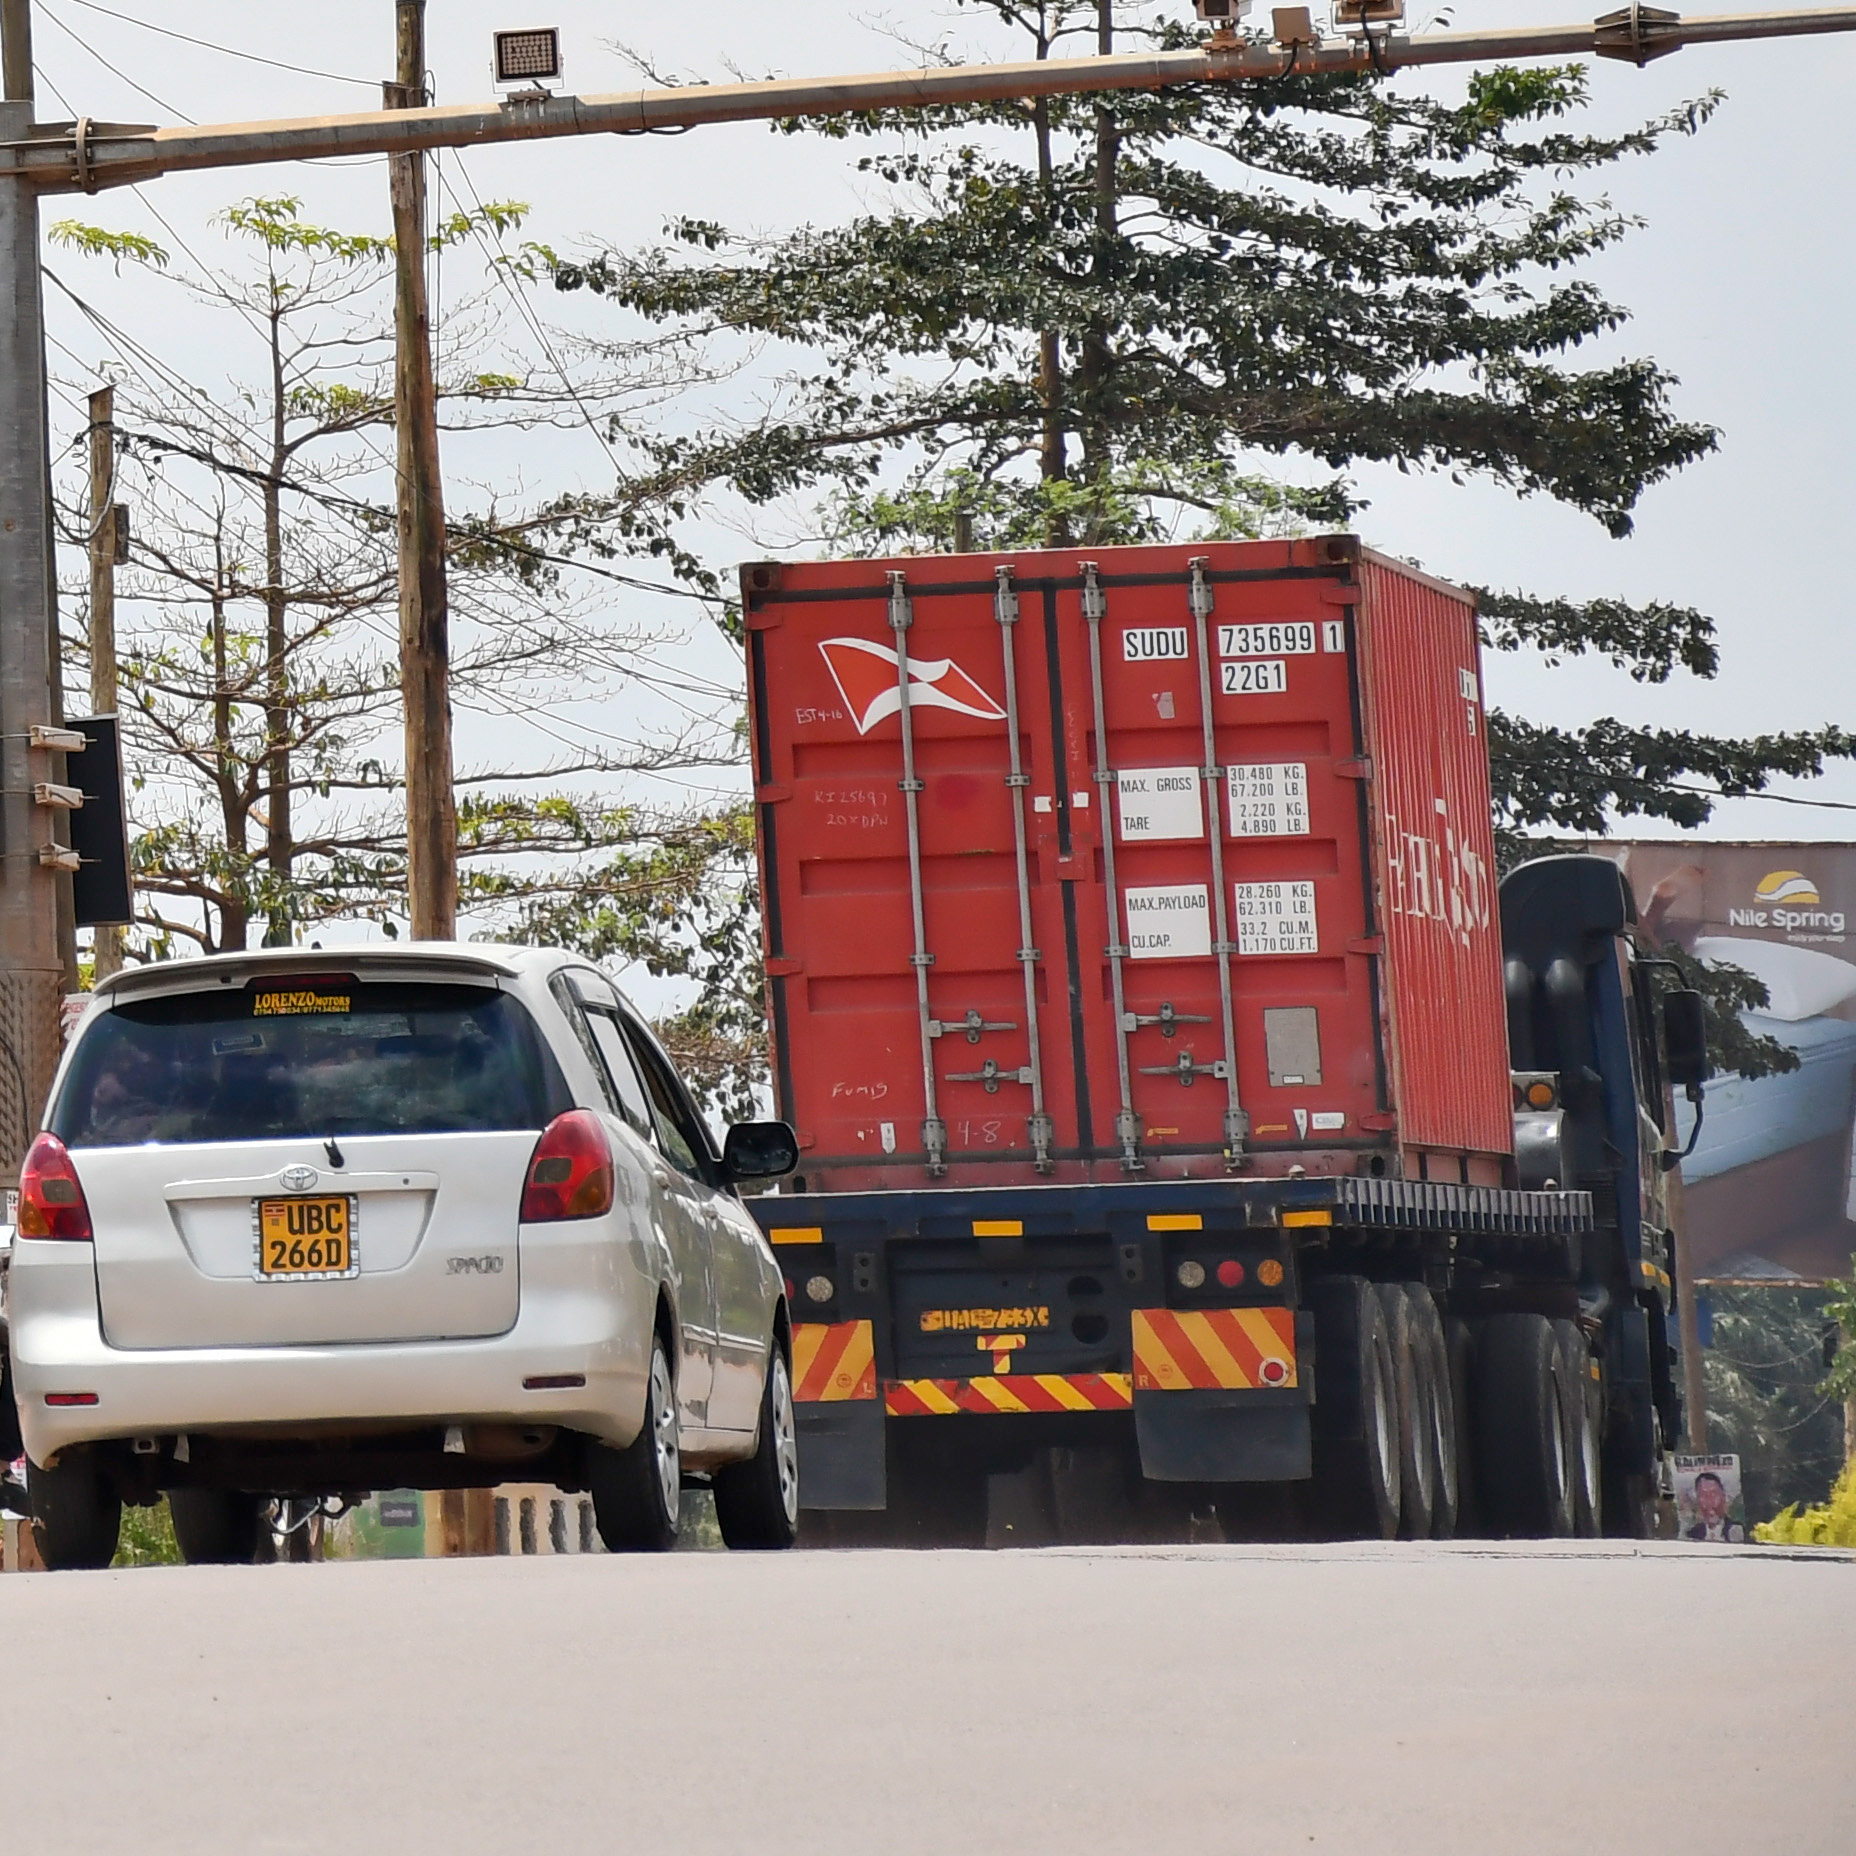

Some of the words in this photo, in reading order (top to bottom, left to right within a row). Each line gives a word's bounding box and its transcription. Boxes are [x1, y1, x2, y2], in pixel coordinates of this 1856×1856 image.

[1126, 630, 1186, 659] SUDU
[1220, 625, 1313, 654] 735699
[1328, 624, 1338, 650] 1
[1224, 663, 1282, 692] 22G1
[1230, 766, 1273, 781] 30.480
[1283, 765, 1305, 780] KG.
[1120, 779, 1150, 793] MAX.
[1156, 777, 1192, 792] GROSS
[1231, 783, 1274, 798] 67.200
[1240, 802, 1276, 817] 2.220
[1286, 801, 1307, 816] KG.
[1123, 816, 1150, 831] TARE
[1241, 819, 1276, 834] 4.890
[1287, 818, 1306, 832] LB.
[1238, 884, 1281, 899] 28.260
[1292, 883, 1313, 898] KG.
[1239, 901, 1282, 916] 62.310
[1292, 900, 1312, 915] LB.
[1240, 921, 1268, 936] 33.2
[1278, 920, 1314, 935] CU.M.
[1729, 908, 1769, 928] Nile
[1771, 908, 1845, 932] Spring
[1242, 938, 1276, 952] 1.170
[1279, 936, 1316, 951] CU.FT.
[254, 991, 315, 1009] LORENZO
[315, 996, 351, 1006] MOTORS
[287, 1203, 343, 1236] UBC
[270, 1238, 342, 1270] 266D
